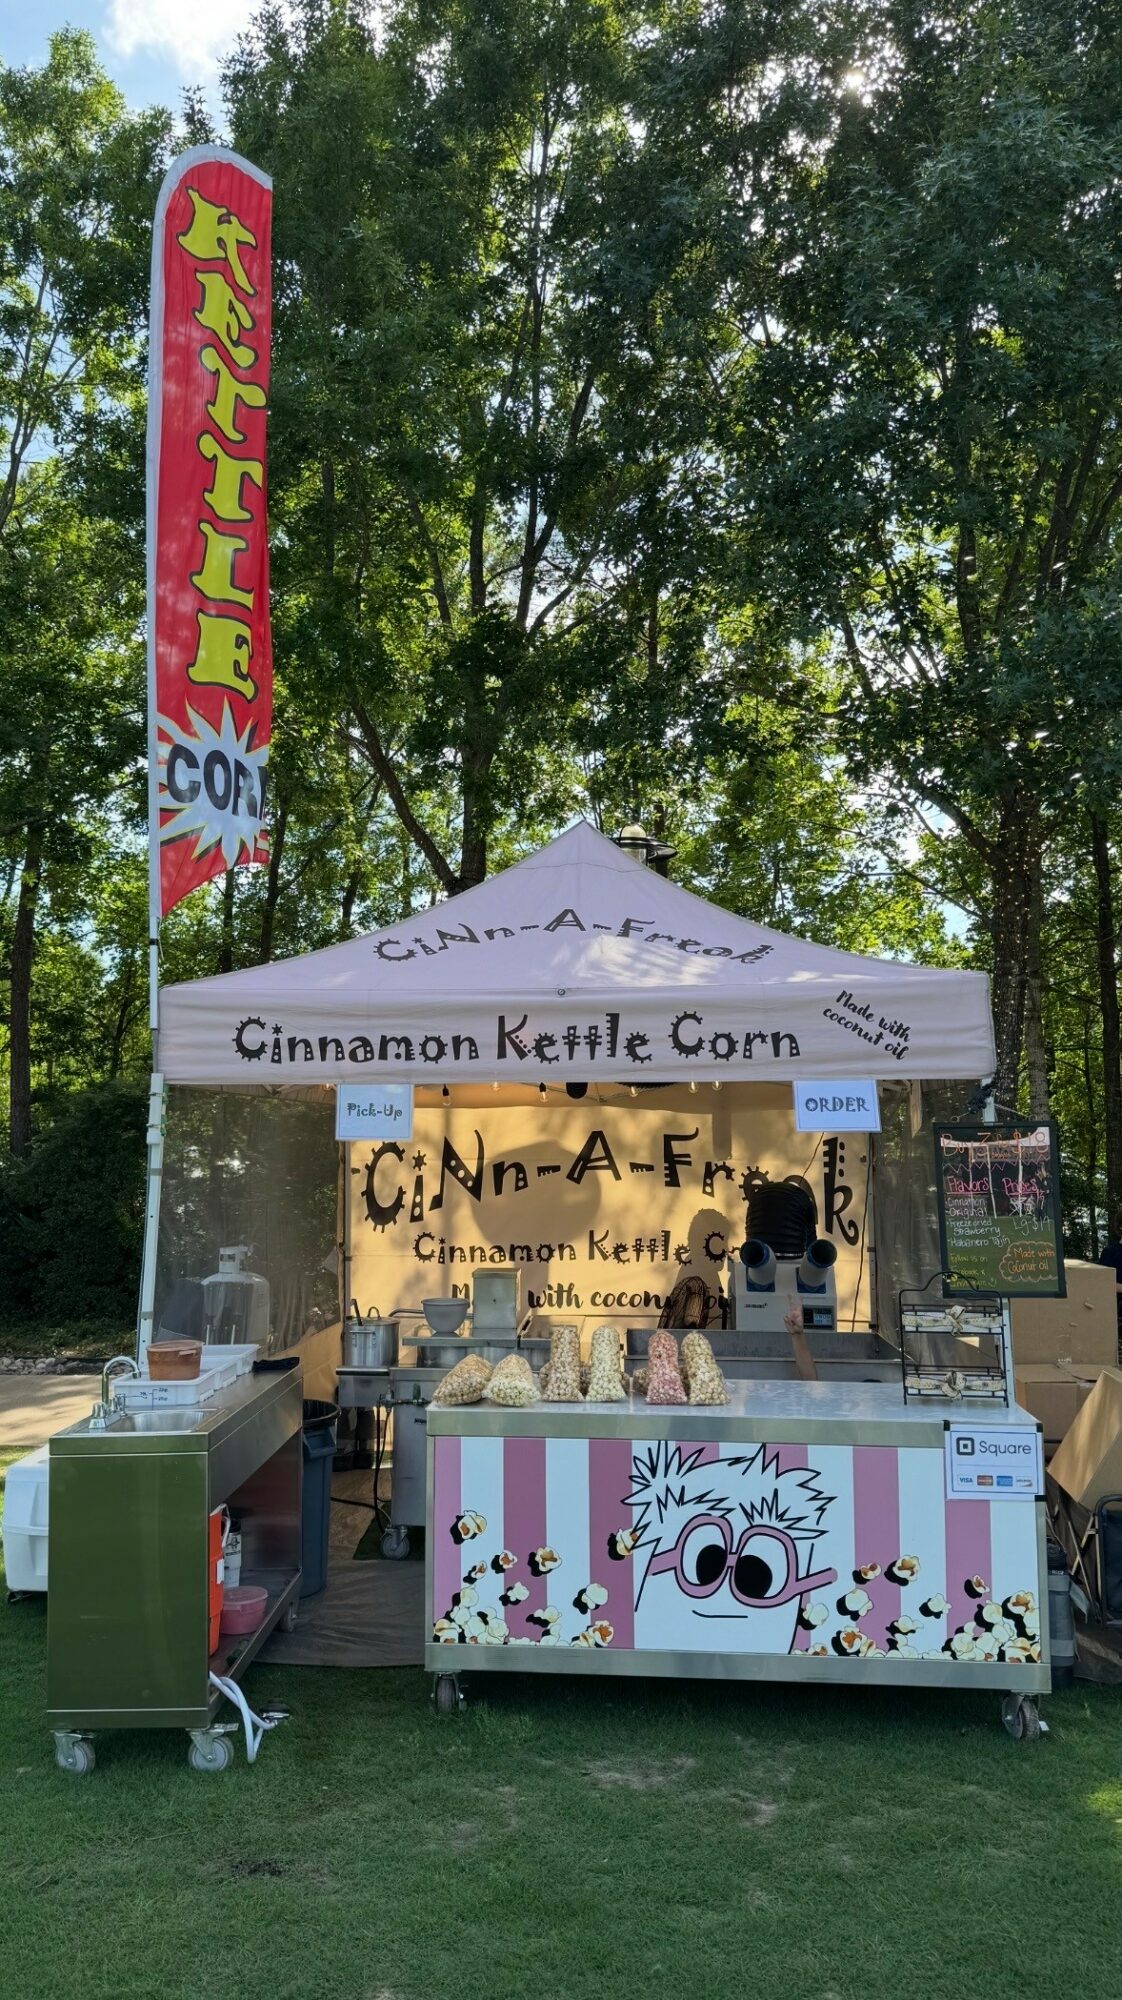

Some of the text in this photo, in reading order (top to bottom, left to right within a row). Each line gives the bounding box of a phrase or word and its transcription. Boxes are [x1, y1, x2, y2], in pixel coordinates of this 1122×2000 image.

[836, 990, 911, 1042] Made with
[232, 1011, 801, 1065] Cinnamon Kettle Corn
[823, 1008, 909, 1060] coconut oil
[347, 1102, 403, 1122] Pick-Up
[805, 1096, 870, 1112] ORDER
[948, 1176, 990, 1192] Flavors
[412, 1231, 577, 1265] Cinnamon
[588, 1229, 694, 1266] Kettle
[527, 1283, 583, 1309] with
[979, 1440, 1032, 1456] Square
